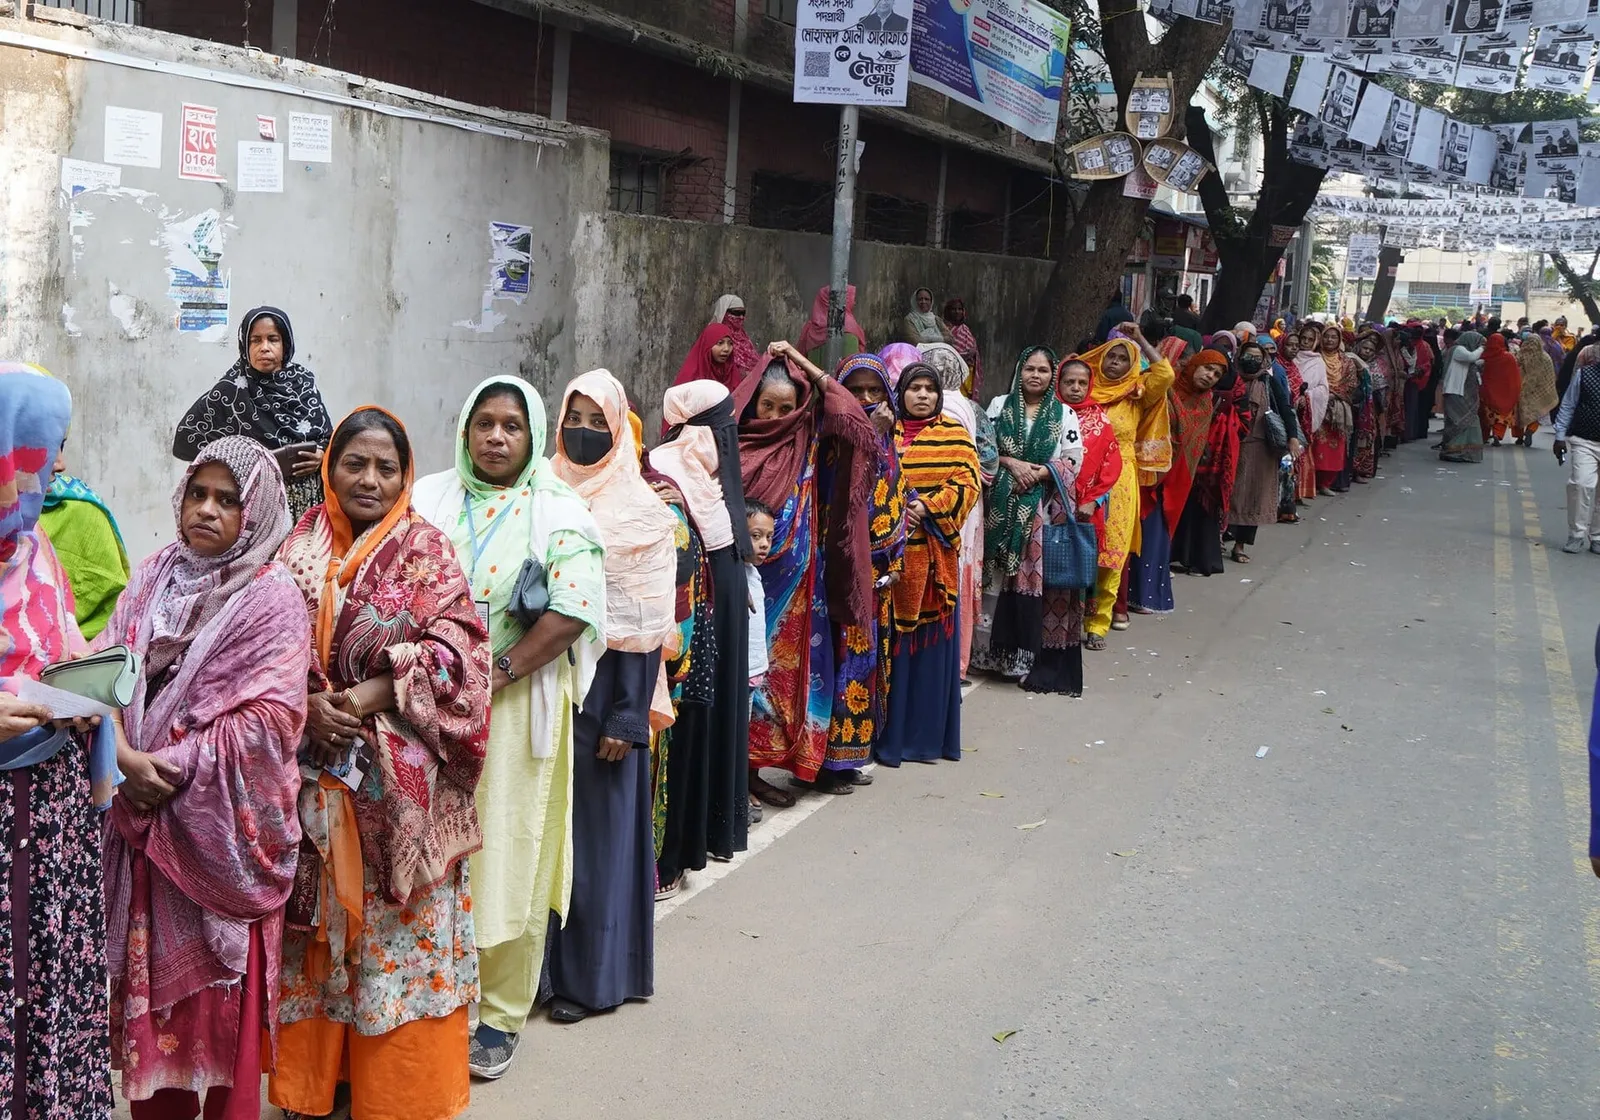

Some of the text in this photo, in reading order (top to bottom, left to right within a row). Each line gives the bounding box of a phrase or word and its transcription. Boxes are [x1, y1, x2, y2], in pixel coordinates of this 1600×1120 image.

[815, 8, 845, 23] পদপ্রার্থী
[801, 23, 908, 46] মোহাম্মদ আলী আরাফাত
[836, 49, 850, 60] কে
[848, 51, 896, 80] নৌকায়
[863, 72, 895, 87] ভোট
[874, 84, 893, 97] দিন
[185, 153, 215, 167] 0164
[838, 124, 849, 192] 28747
